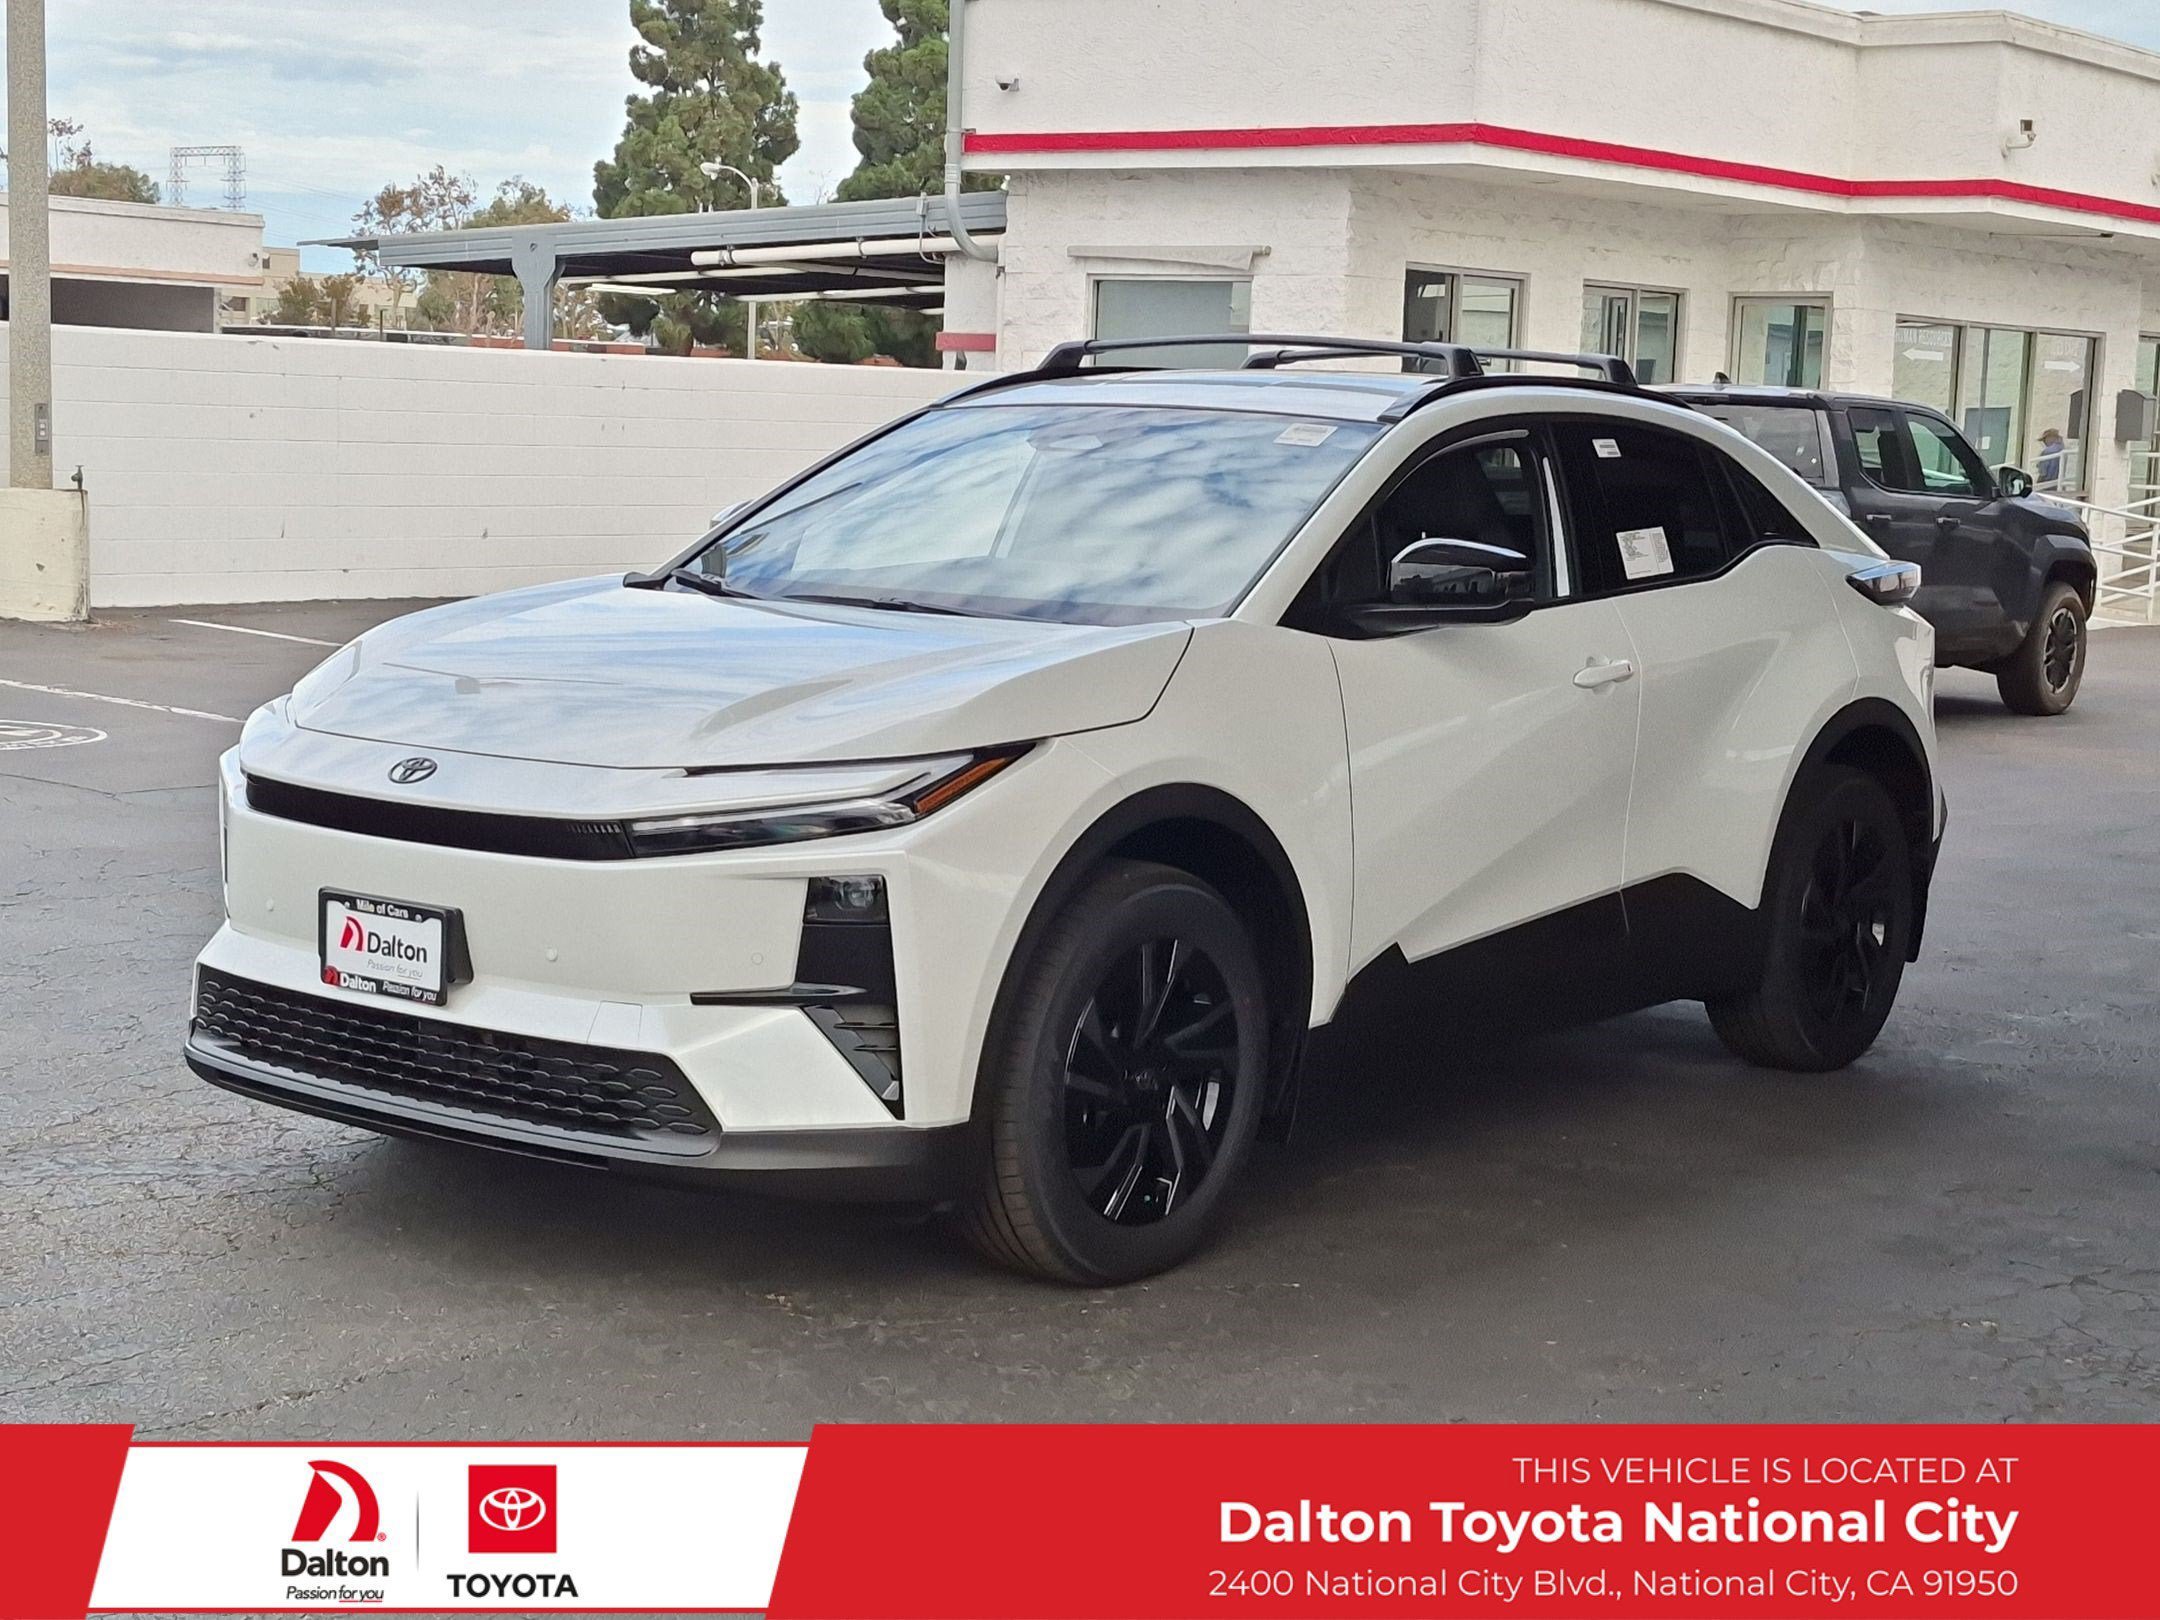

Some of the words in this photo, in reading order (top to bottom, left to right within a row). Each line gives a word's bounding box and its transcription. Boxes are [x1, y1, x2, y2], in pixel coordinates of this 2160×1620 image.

[356, 899, 375, 913] Mile
[376, 904, 386, 915] of
[387, 904, 409, 918] Cars
[367, 931, 427, 963] Dalton
[368, 959, 395, 971] Passion
[397, 964, 408, 975] for
[408, 968, 423, 979] you
[339, 973, 377, 993] Dalton
[383, 981, 410, 996] Passion
[411, 986, 422, 998] for
[422, 991, 437, 1002] you
